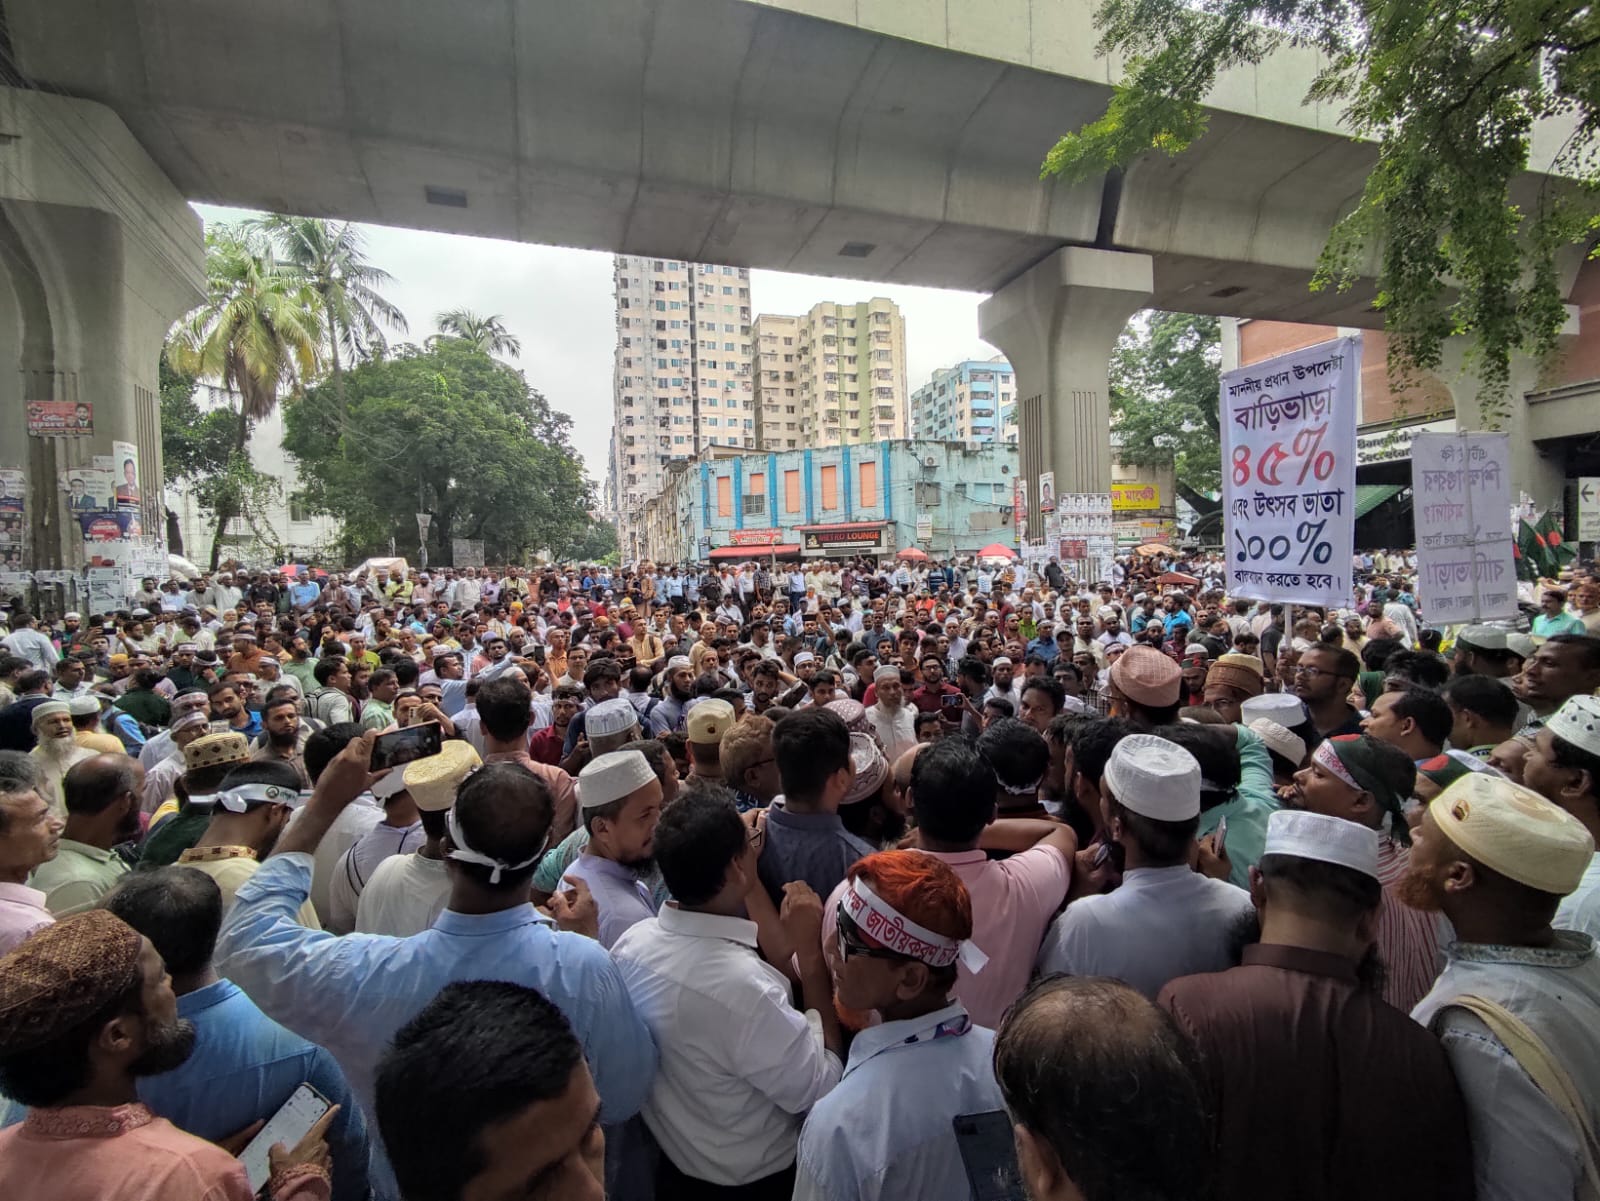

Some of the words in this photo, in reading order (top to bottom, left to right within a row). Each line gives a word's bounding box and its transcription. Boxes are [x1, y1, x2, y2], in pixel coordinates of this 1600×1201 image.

[1264, 370, 1290, 388] প্রধান
[1292, 354, 1345, 380] উপদেষ্টা
[1233, 384, 1337, 431] বাড়িভাড়া
[1231, 421, 1336, 487] ৪৫%
[1232, 498, 1250, 520] এবং
[1253, 489, 1298, 518] উৎসব
[1302, 487, 1345, 518] ভাতা
[847, 531, 880, 540] LOUNGE
[1234, 518, 1333, 566] ১০০%
[1265, 572, 1303, 588] করতে
[866, 907, 941, 963] জাতীয়করণ
